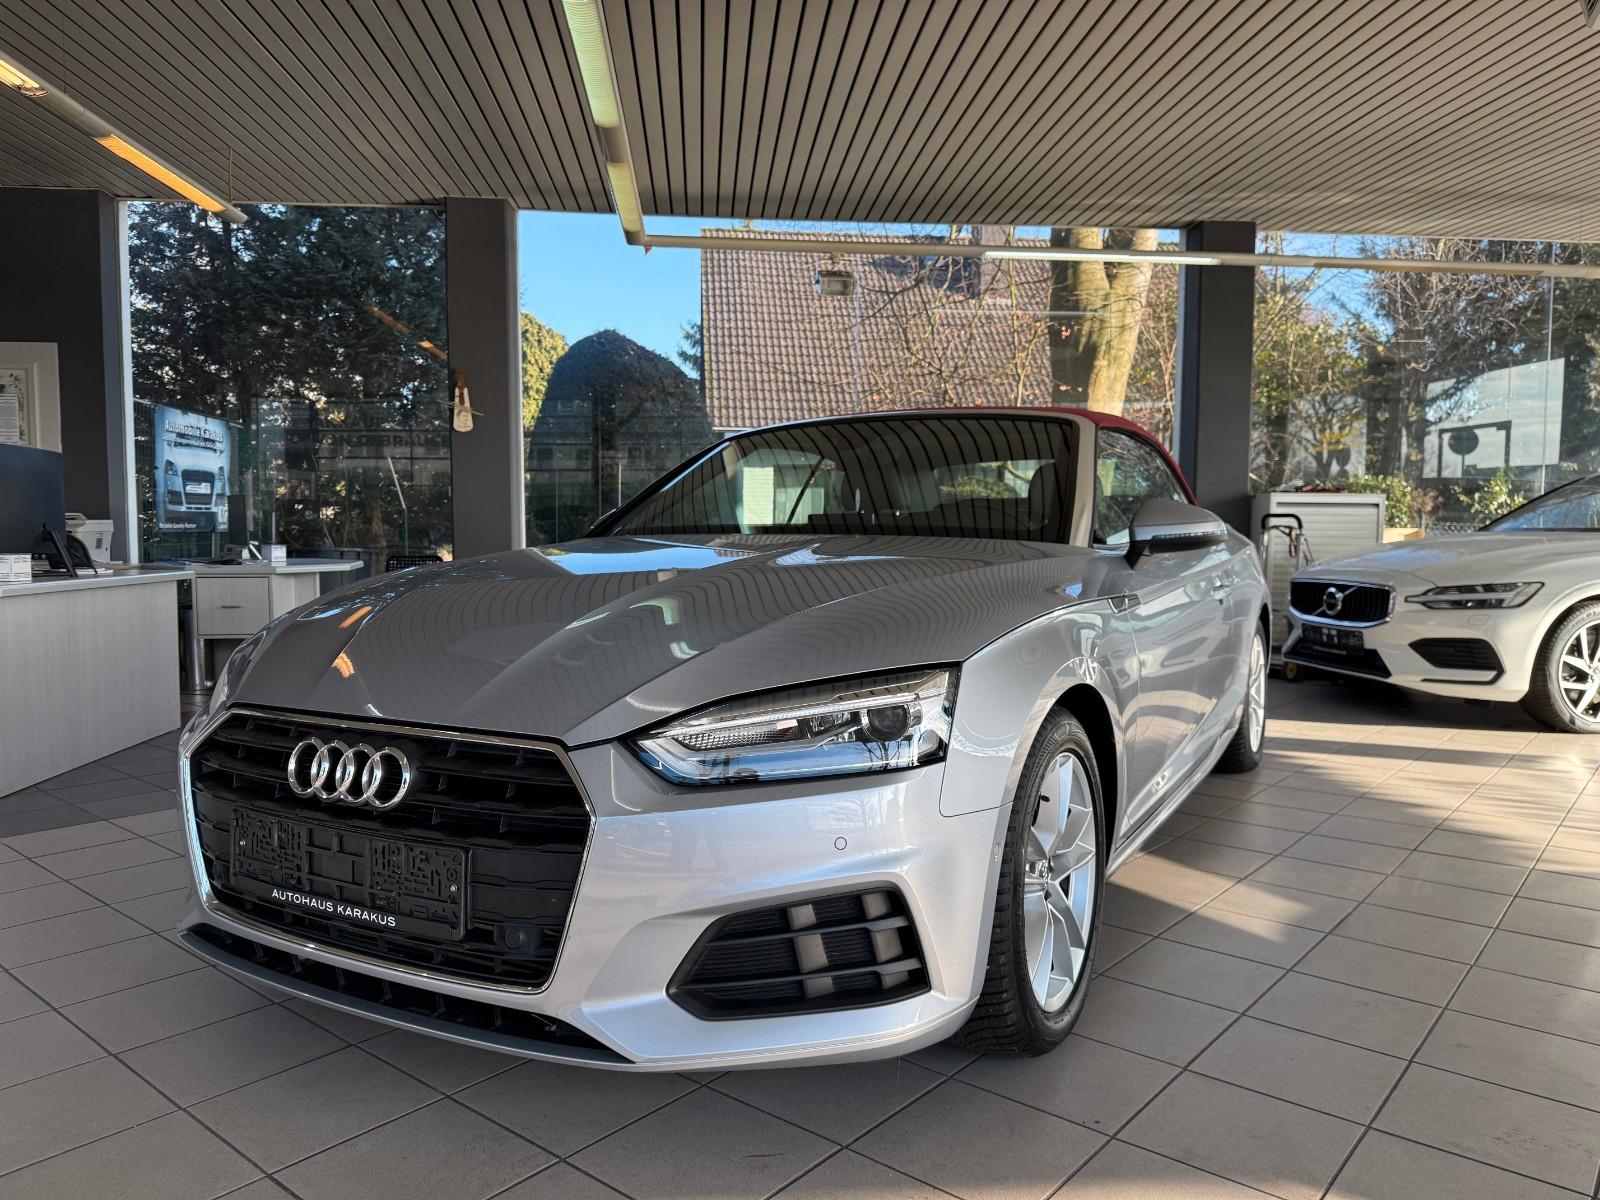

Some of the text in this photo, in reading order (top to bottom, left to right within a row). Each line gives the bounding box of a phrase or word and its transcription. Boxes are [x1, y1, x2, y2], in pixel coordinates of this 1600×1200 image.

[164, 419, 201, 436] Automobile
[271, 888, 396, 927] AUTOHAUS KARAKUS
